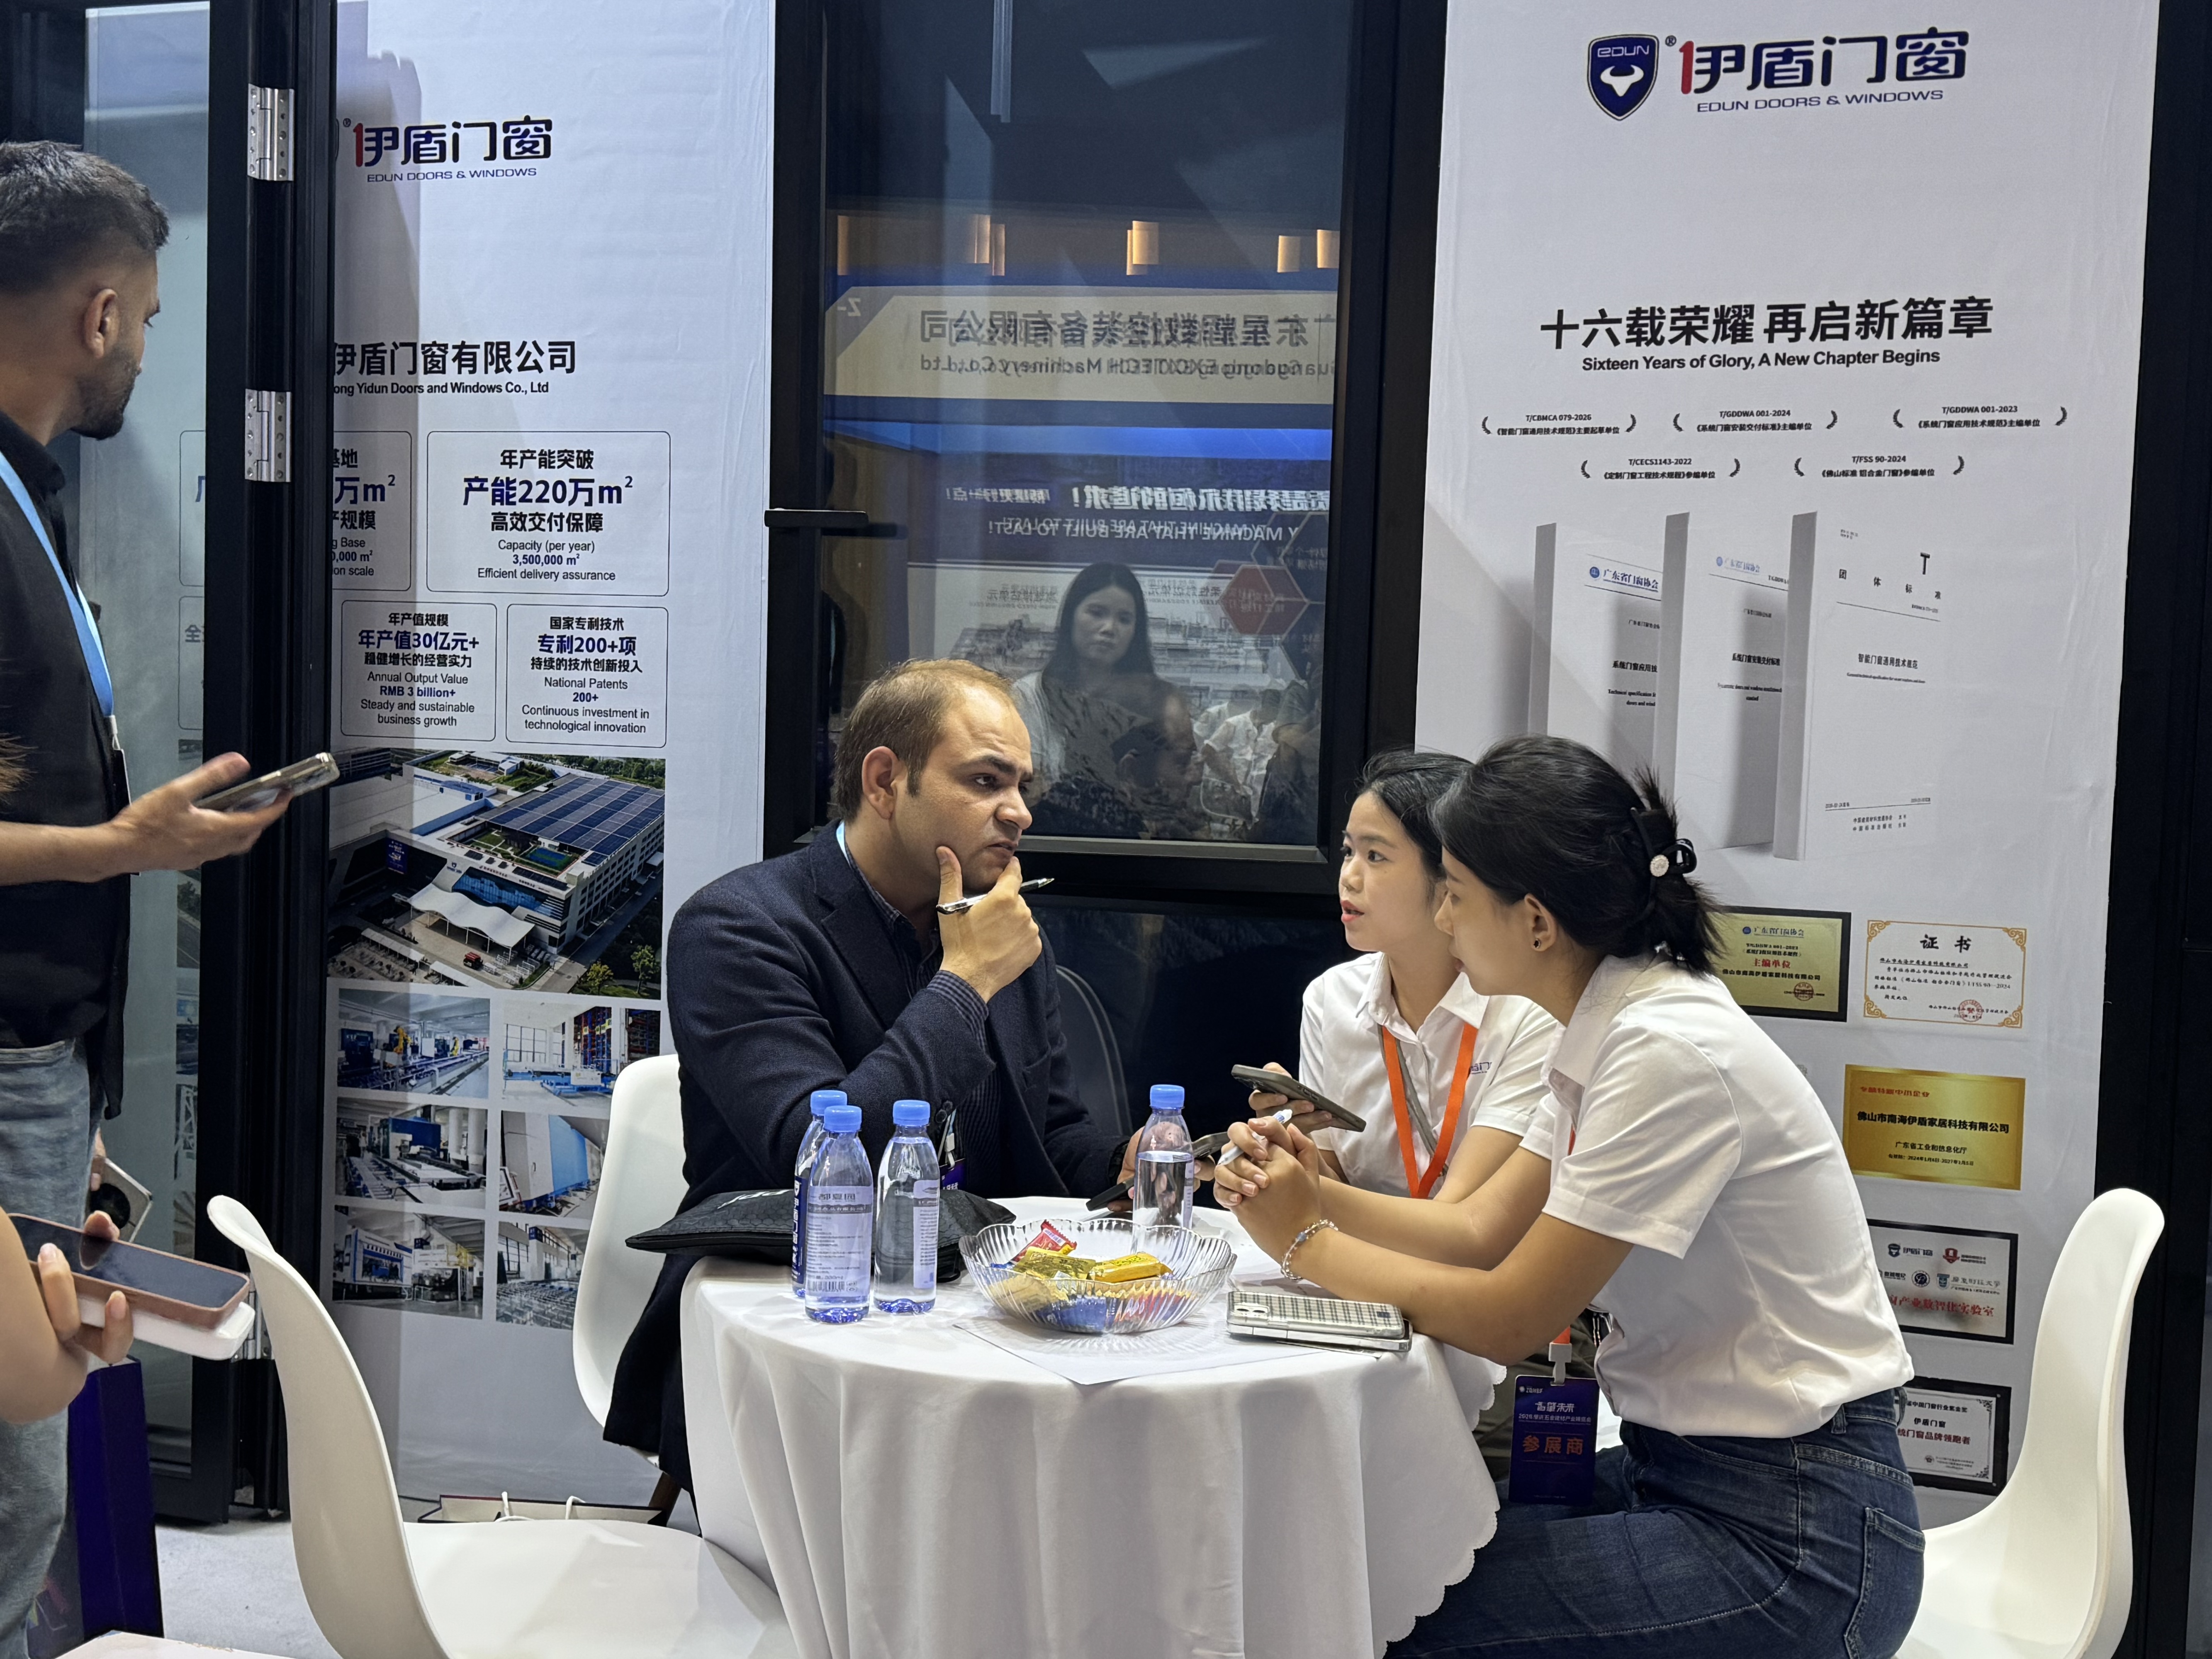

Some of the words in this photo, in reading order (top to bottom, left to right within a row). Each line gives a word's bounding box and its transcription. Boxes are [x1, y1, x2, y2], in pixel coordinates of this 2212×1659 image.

[1597, 45, 1650, 57] EDUN
[1679, 27, 1969, 94] 伊盾门窗
[1697, 101, 1748, 112] EDUN
[1755, 97, 1820, 109] DOORS
[1826, 95, 1840, 105] &
[1845, 90, 1943, 104] WINDOWS
[353, 115, 552, 167] 伊盾门窗
[367, 173, 403, 182] EDUN
[407, 171, 452, 180] DOORS
[469, 168, 536, 178] WINDOWS
[1540, 304, 1755, 349] 十六载荣耀
[1764, 296, 1993, 343] 再启新篇章
[1582, 358, 1638, 371] Sixteen
[1643, 356, 1686, 369] Years
[1690, 355, 1706, 368] of
[1709, 354, 1755, 370] Glory,
[1758, 353, 1771, 366] A
[1774, 353, 1810, 366] New
[1813, 351, 1879, 367] Chapter
[1883, 349, 1940, 366] Begins
[356, 383, 388, 394] Yidun
[391, 383, 424, 394] Doors
[427, 382, 448, 393] and
[450, 382, 502, 393] Windows
[505, 382, 527, 395] Co.,
[530, 382, 548, 393] Ltd
[1942, 406, 1979, 415] T/GDDWA
[500, 450, 594, 469] 年产能突破
[491, 513, 603, 533] 高效交付保障
[341, 537, 365, 547] Base
[498, 540, 542, 553] Capacity
[545, 540, 566, 553] (per
[569, 541, 594, 553] year)
[513, 555, 563, 566] 3,500,000
[1920, 552, 1930, 575] T
[348, 565, 374, 576] scale
[478, 568, 517, 579] Efficient
[520, 569, 559, 582] delivery
[562, 572, 616, 580] assurance
[388, 613, 448, 626] 年产值规模
[550, 617, 624, 631] 国家专利技术
[358, 630, 479, 651] 年产值30亿元+
[538, 635, 637, 656] 专利200+项
[531, 658, 642, 674] 持续的技术创新投入
[367, 671, 401, 682] Annual
[405, 672, 438, 685] Output
[440, 673, 468, 684] Value
[545, 677, 586, 688] National
[589, 678, 628, 689] Patents
[380, 686, 404, 696] RMB
[408, 687, 414, 696] 3
[417, 687, 455, 698] billion+
[573, 692, 599, 702] 200+
[361, 699, 394, 712] Steady
[397, 701, 416, 710] and
[419, 702, 475, 713] sustainable
[522, 705, 579, 716] Continuous
[582, 707, 638, 718] investment
[641, 709, 649, 719] in
[378, 713, 421, 725] business
[424, 716, 457, 727] growth
[525, 719, 591, 733] technological
[594, 721, 646, 733] innovation
[1920, 934, 1972, 953] 证书
[1857, 1111, 2010, 1134] 佛山市南海伊盾家居科技有限公司
[1914, 1417, 1947, 1428] 伊盾门窗
[1522, 1435, 1584, 1455] 参展商
